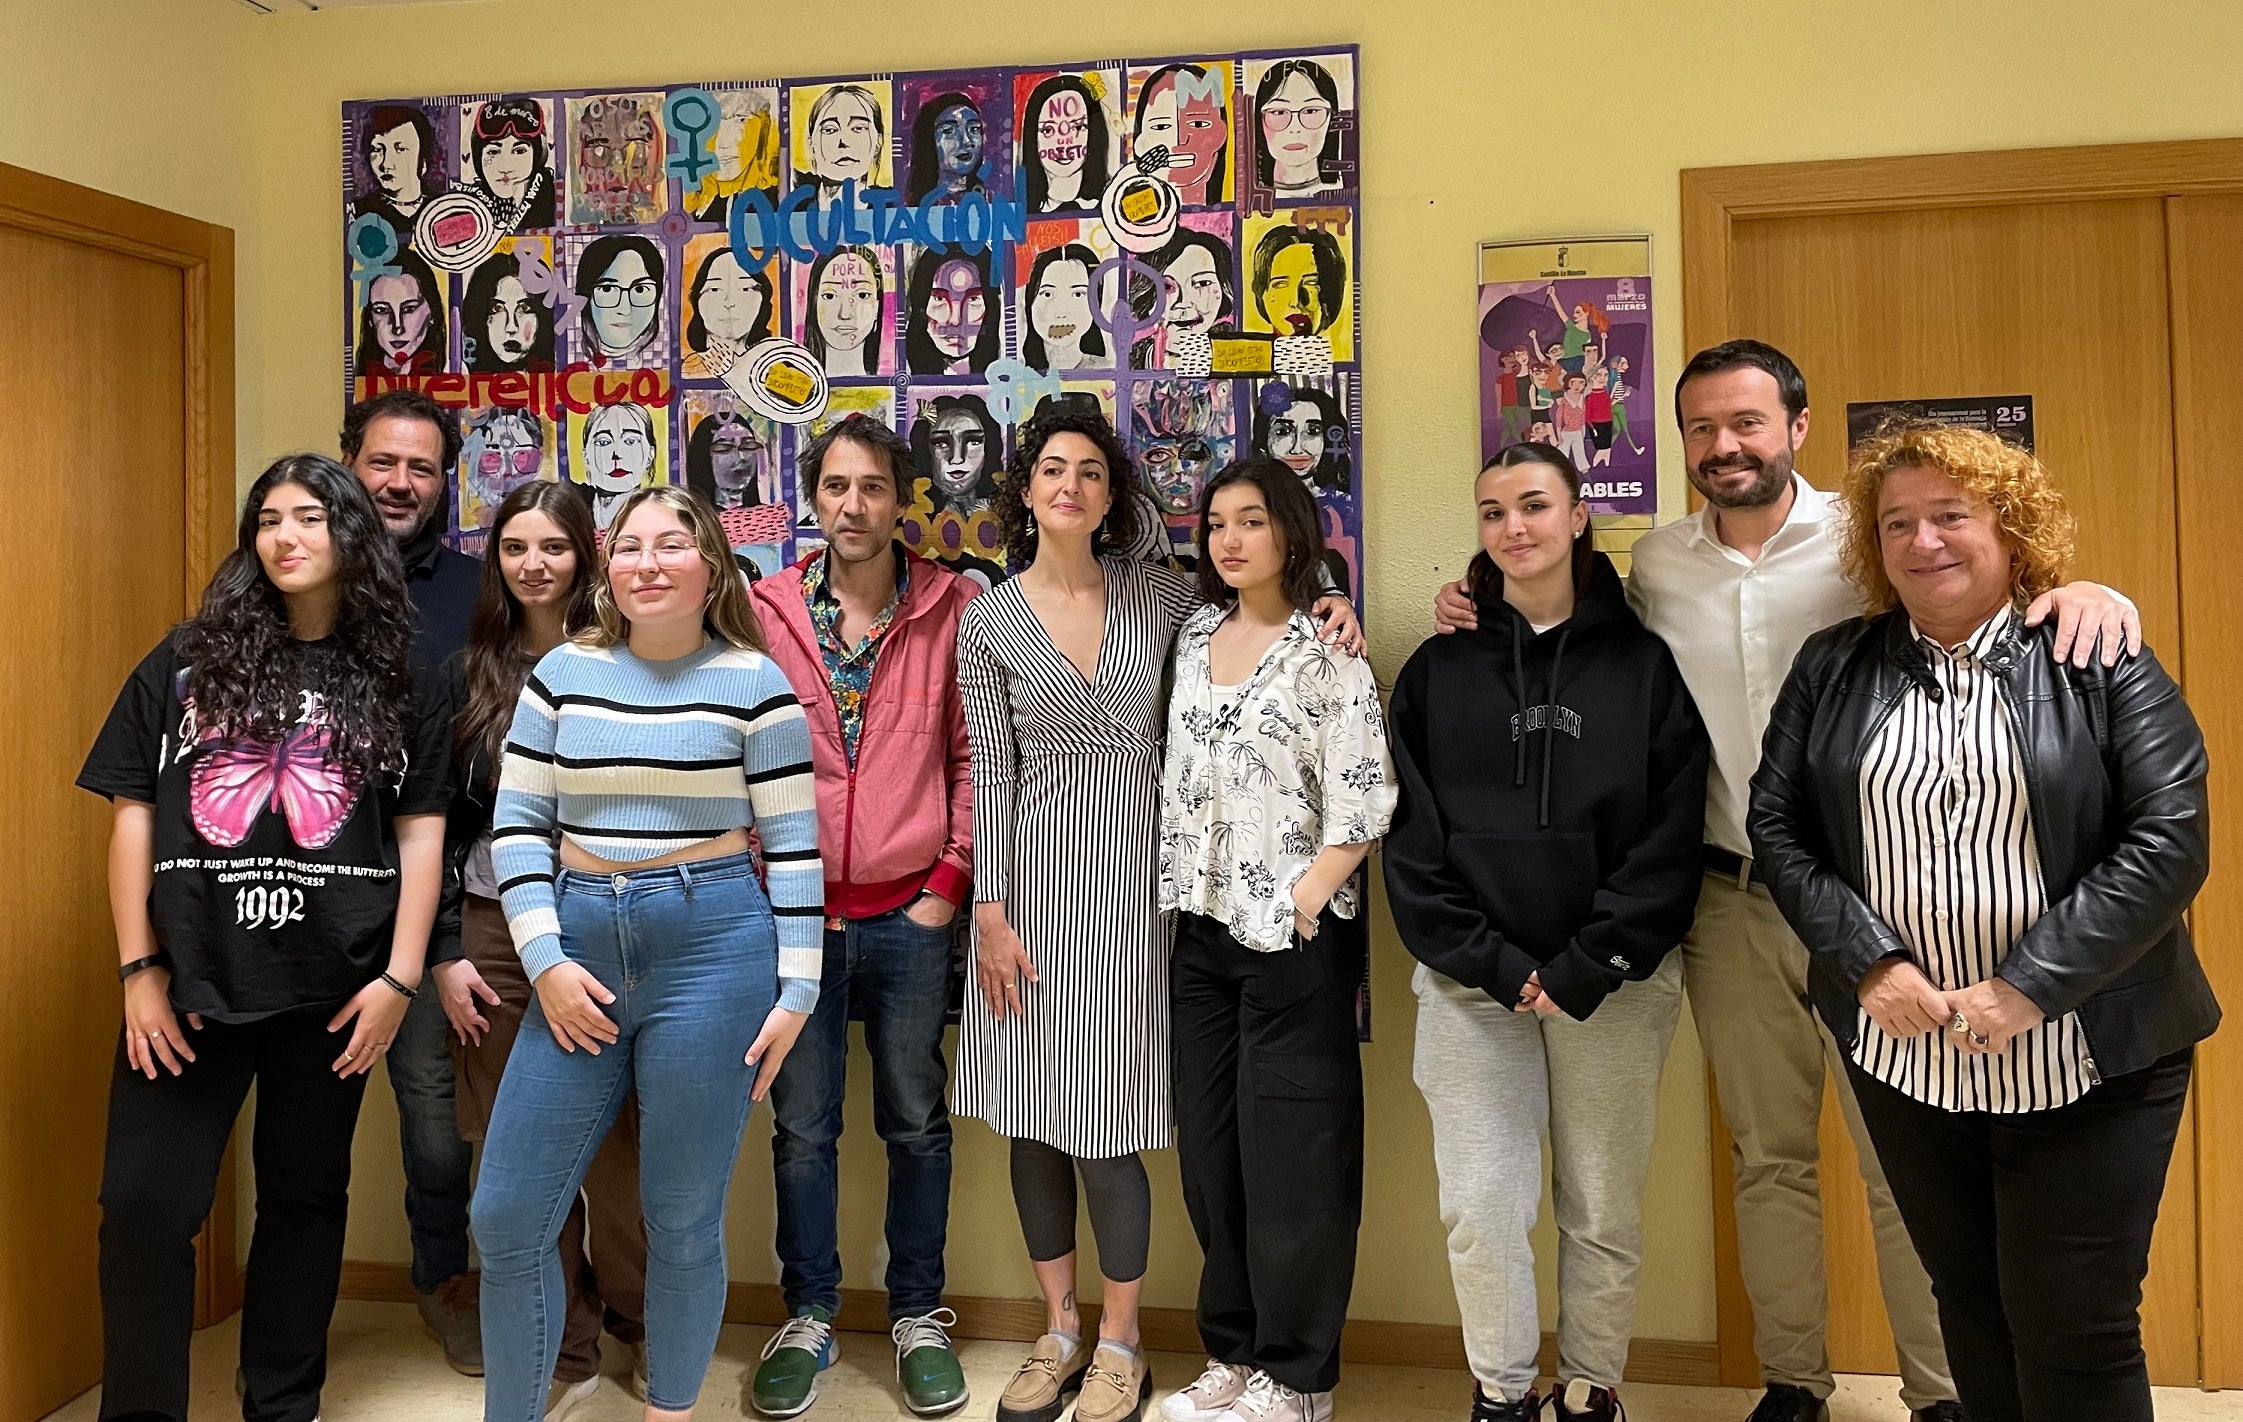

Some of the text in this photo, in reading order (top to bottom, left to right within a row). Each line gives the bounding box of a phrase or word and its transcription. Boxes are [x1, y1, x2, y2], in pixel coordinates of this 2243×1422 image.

[1048, 95, 1079, 119] NO
[485, 105, 540, 127] 8 de marzo
[1616, 278, 1636, 295] 8
[1606, 293, 1646, 302] marzo
[1606, 303, 1647, 311] MUJERES
[1996, 406, 2027, 423] 25
[1580, 481, 1643, 498] ABLES
[160, 860, 175, 872] DO
[176, 858, 201, 869] NOT
[203, 859, 228, 870] JUST
[230, 857, 256, 869] WAKE
[257, 856, 274, 867] UP
[275, 857, 296, 869] AND
[297, 862, 336, 874] BECOME
[337, 865, 352, 876] THE
[217, 870, 326, 887] GROWTH IS A PROCESS
[234, 885, 306, 930] 1992
